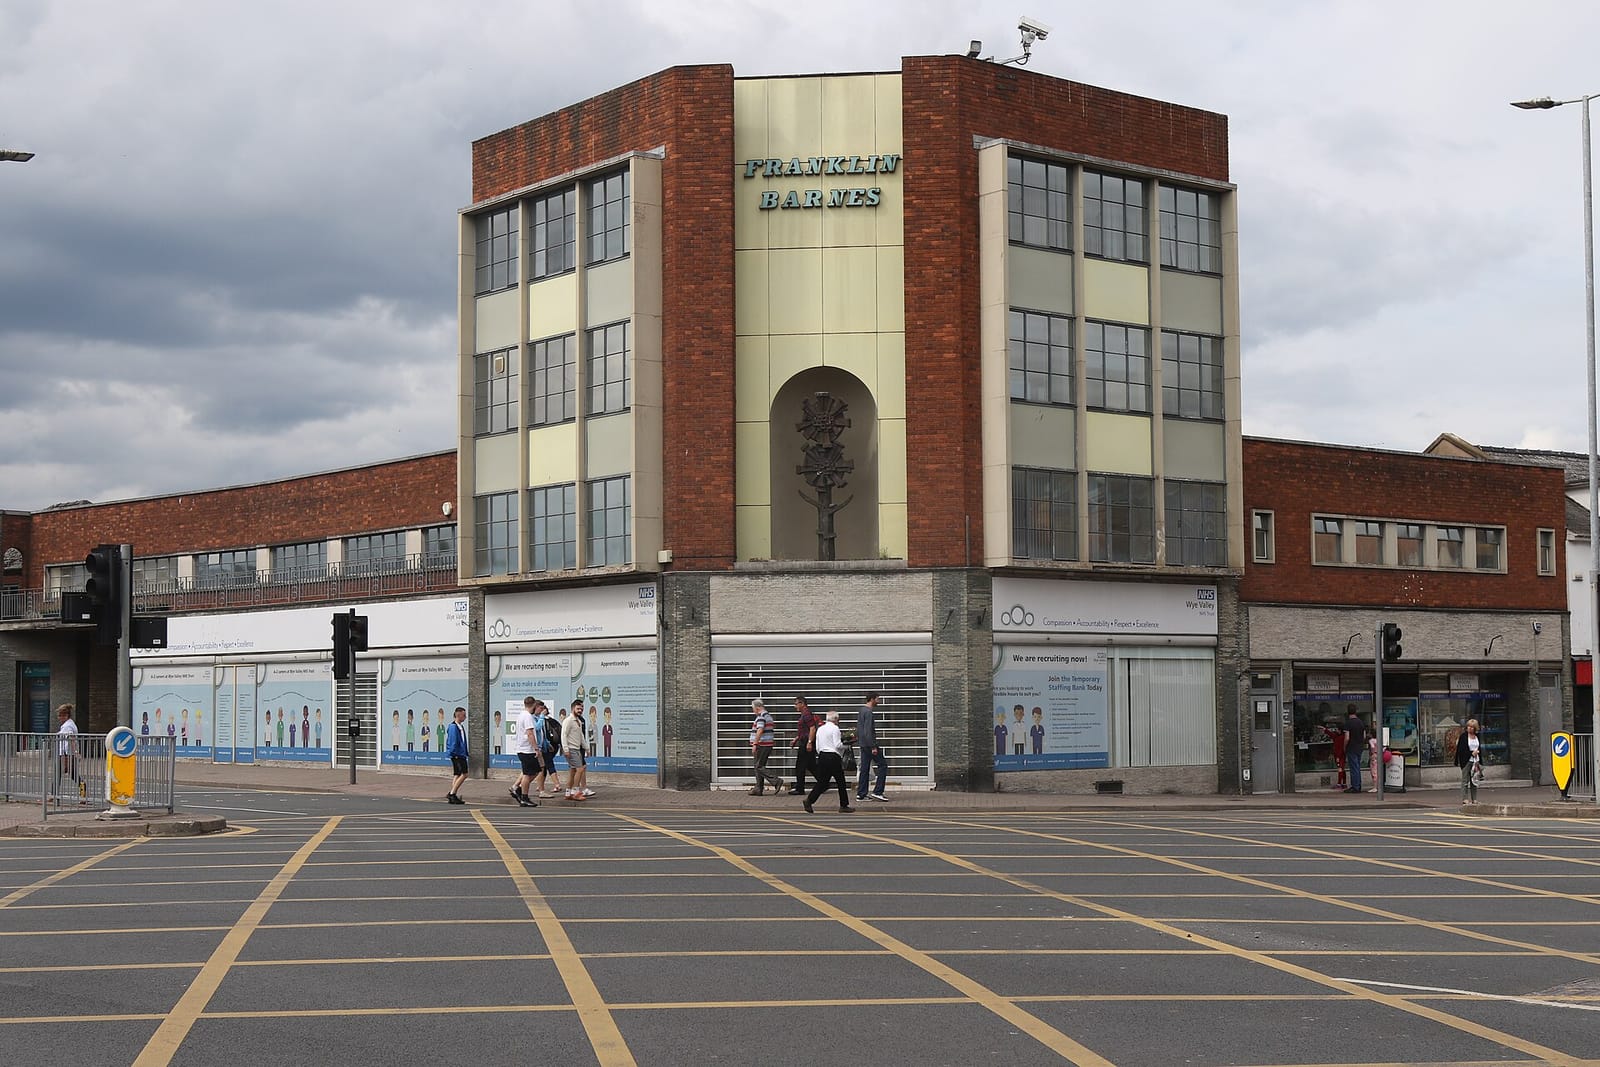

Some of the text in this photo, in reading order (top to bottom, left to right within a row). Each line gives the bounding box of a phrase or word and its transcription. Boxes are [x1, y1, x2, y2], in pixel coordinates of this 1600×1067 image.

[744, 154, 899, 177] FRANKLIN
[759, 188, 881, 209] BARNES
[639, 587, 654, 598] NHS
[1198, 590, 1214, 600] NHS
[455, 602, 467, 611] NHS
[628, 600, 654, 609] Wye Valley
[1185, 601, 1214, 610] Wye Valley
[1043, 617, 1159, 628] Compassion Accountability Respect Excellence
[1037, 655, 1069, 664] recruiting
[521, 662, 544, 671] recruiting
[1087, 684, 1102, 692] Today
